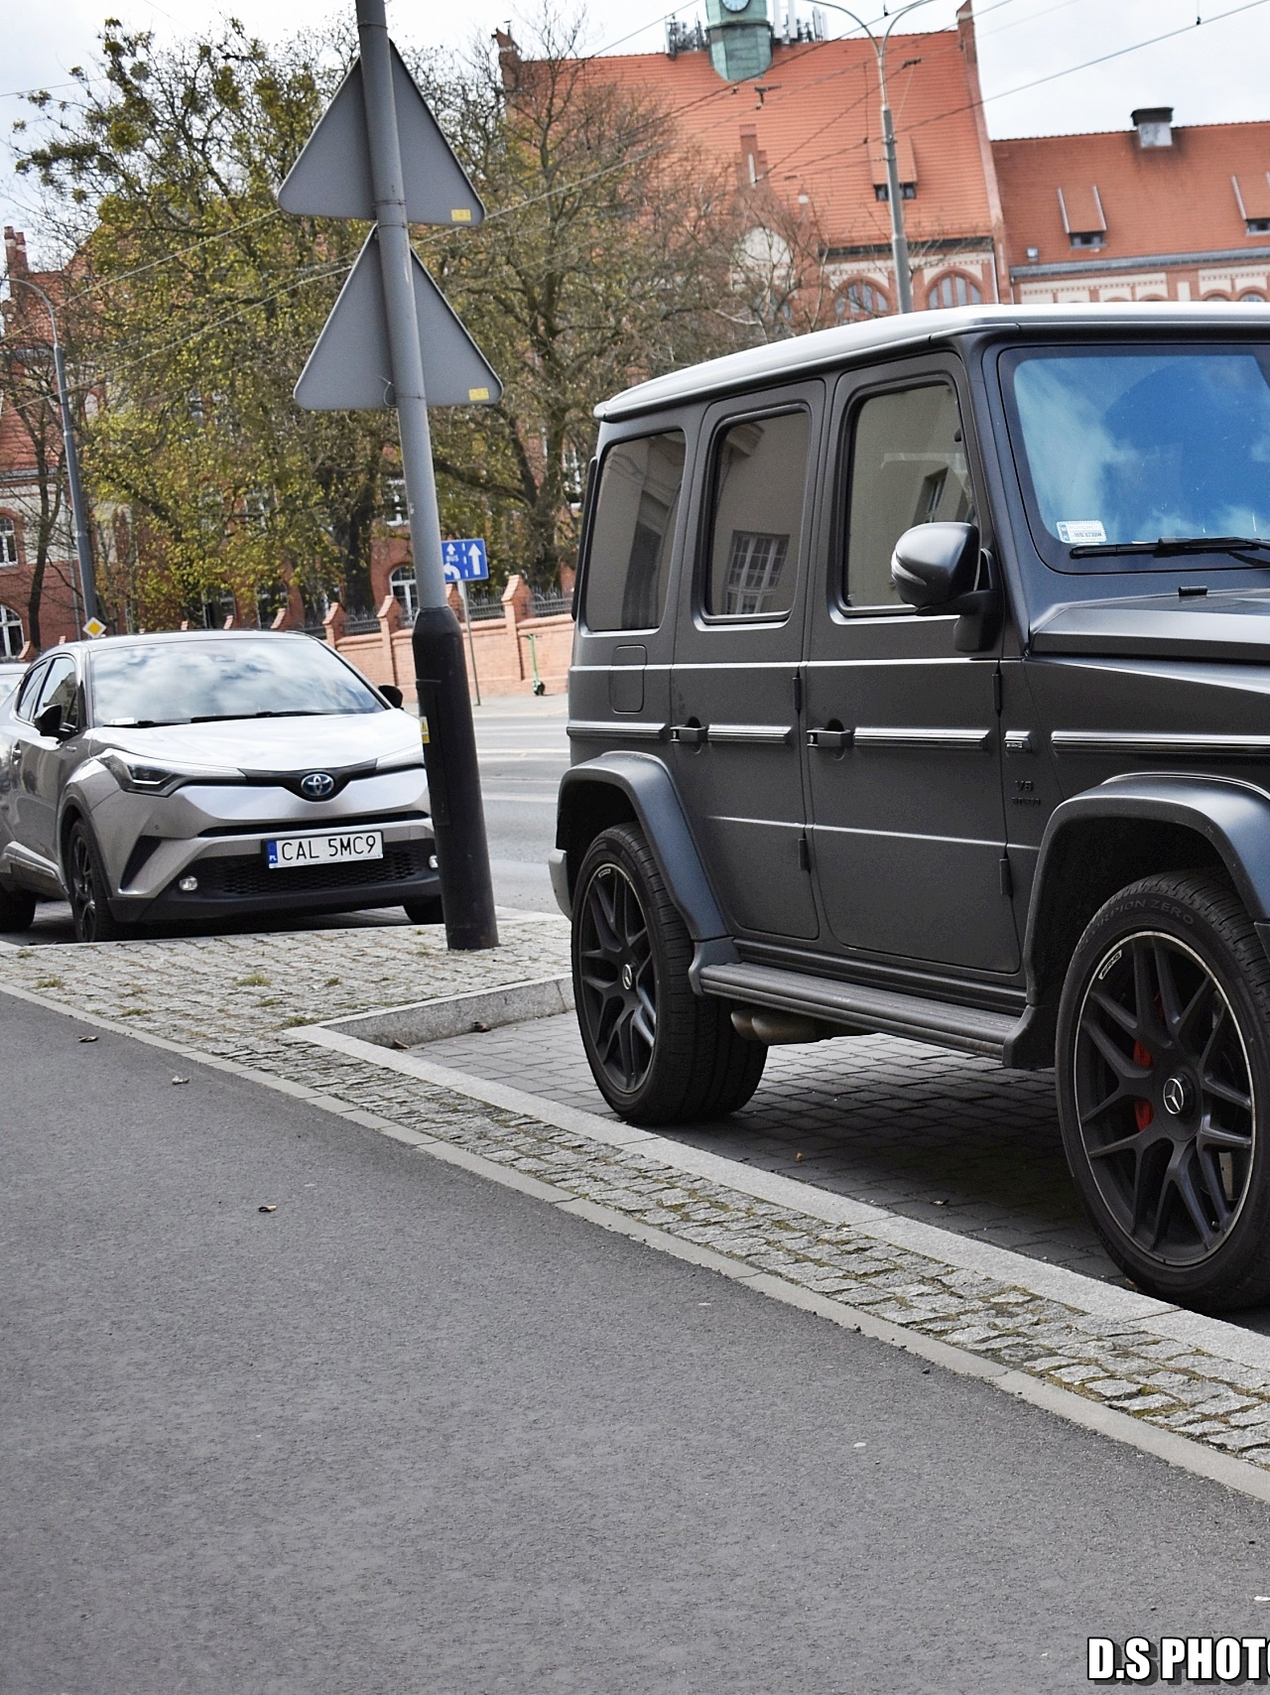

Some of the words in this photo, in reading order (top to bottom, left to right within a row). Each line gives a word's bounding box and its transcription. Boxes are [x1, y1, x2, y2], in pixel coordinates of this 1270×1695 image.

[282, 840, 320, 861] CAL
[328, 835, 376, 857] 5MC9
[1151, 899, 1194, 925] ZERO
